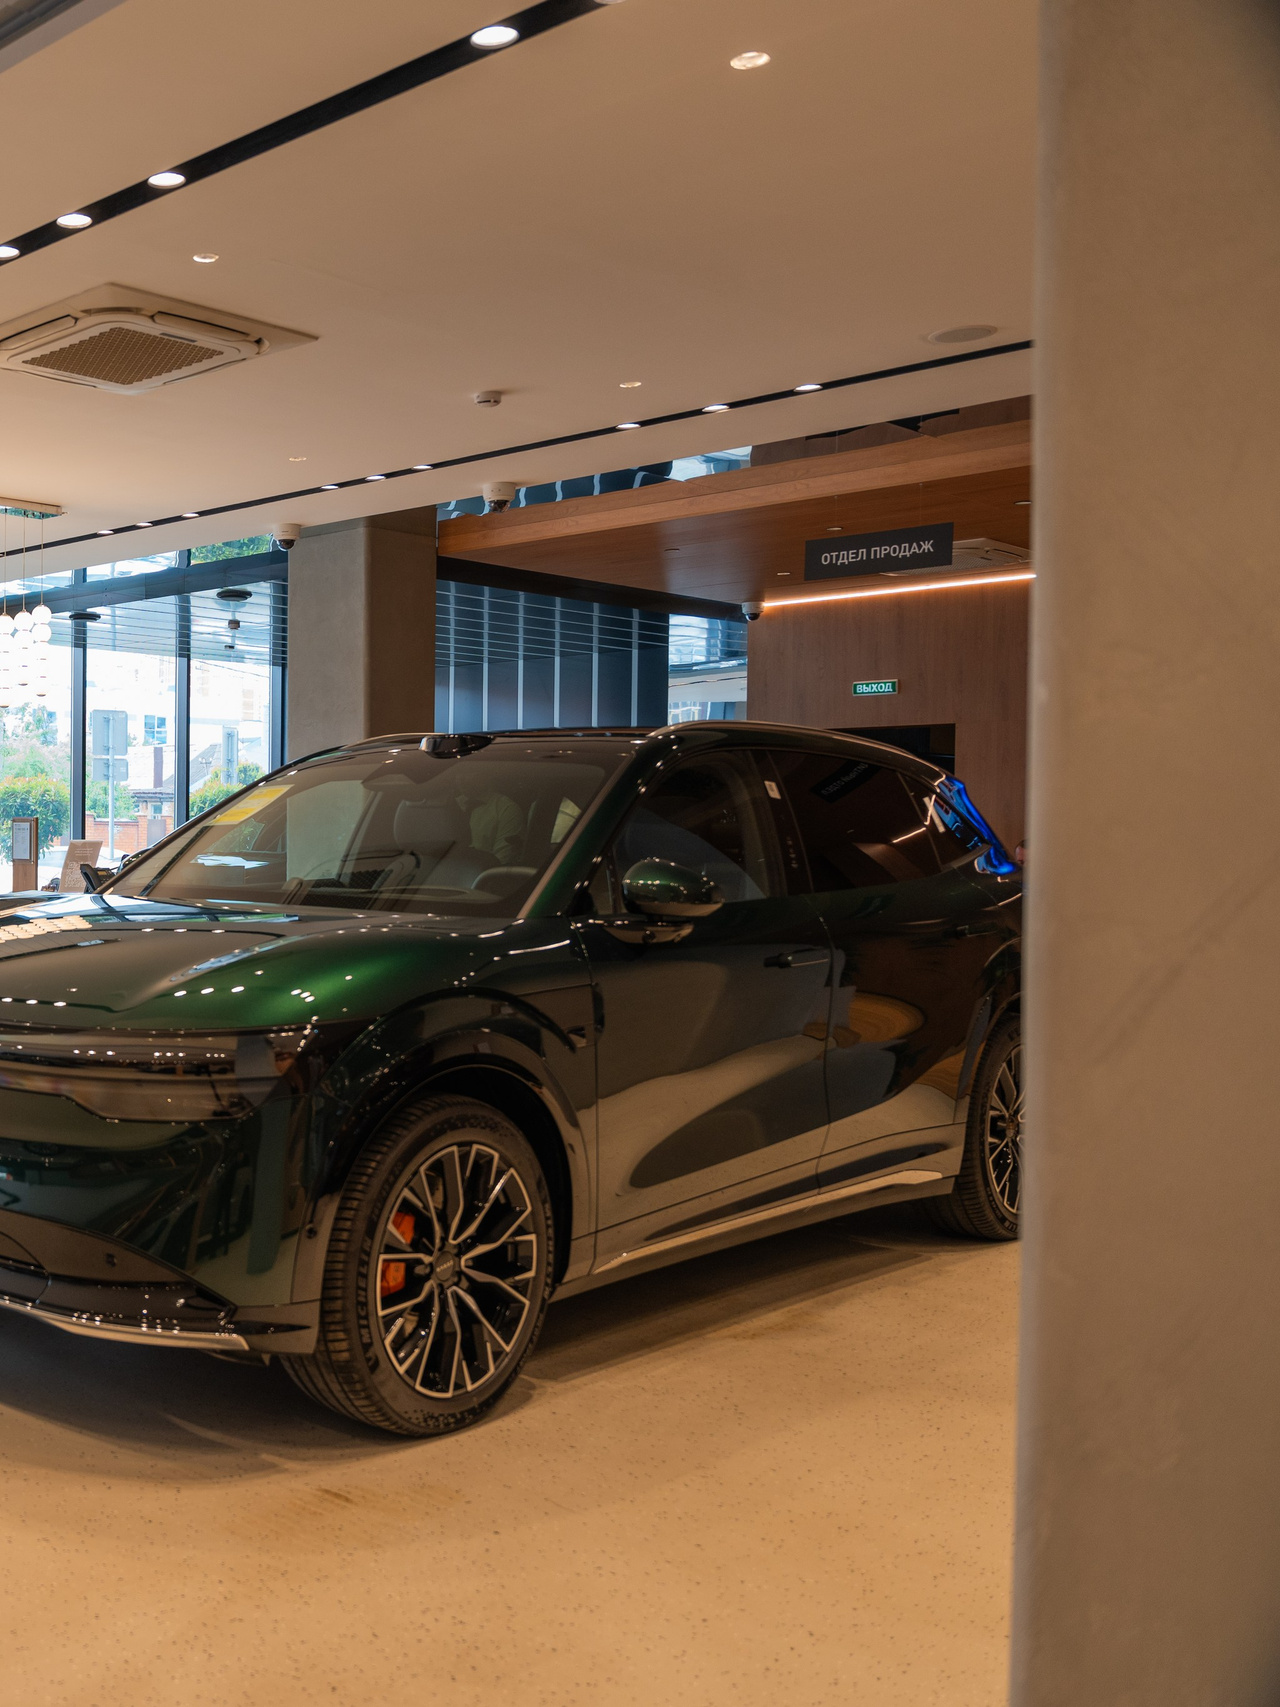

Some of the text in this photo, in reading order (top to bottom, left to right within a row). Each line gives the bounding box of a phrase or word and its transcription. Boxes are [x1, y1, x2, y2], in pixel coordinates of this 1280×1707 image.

[821, 540, 934, 566] ОТДЕЛ ПРОДАЖ
[856, 682, 893, 693] ВЫХОД
[356, 1235, 372, 1345] MICHELIN
